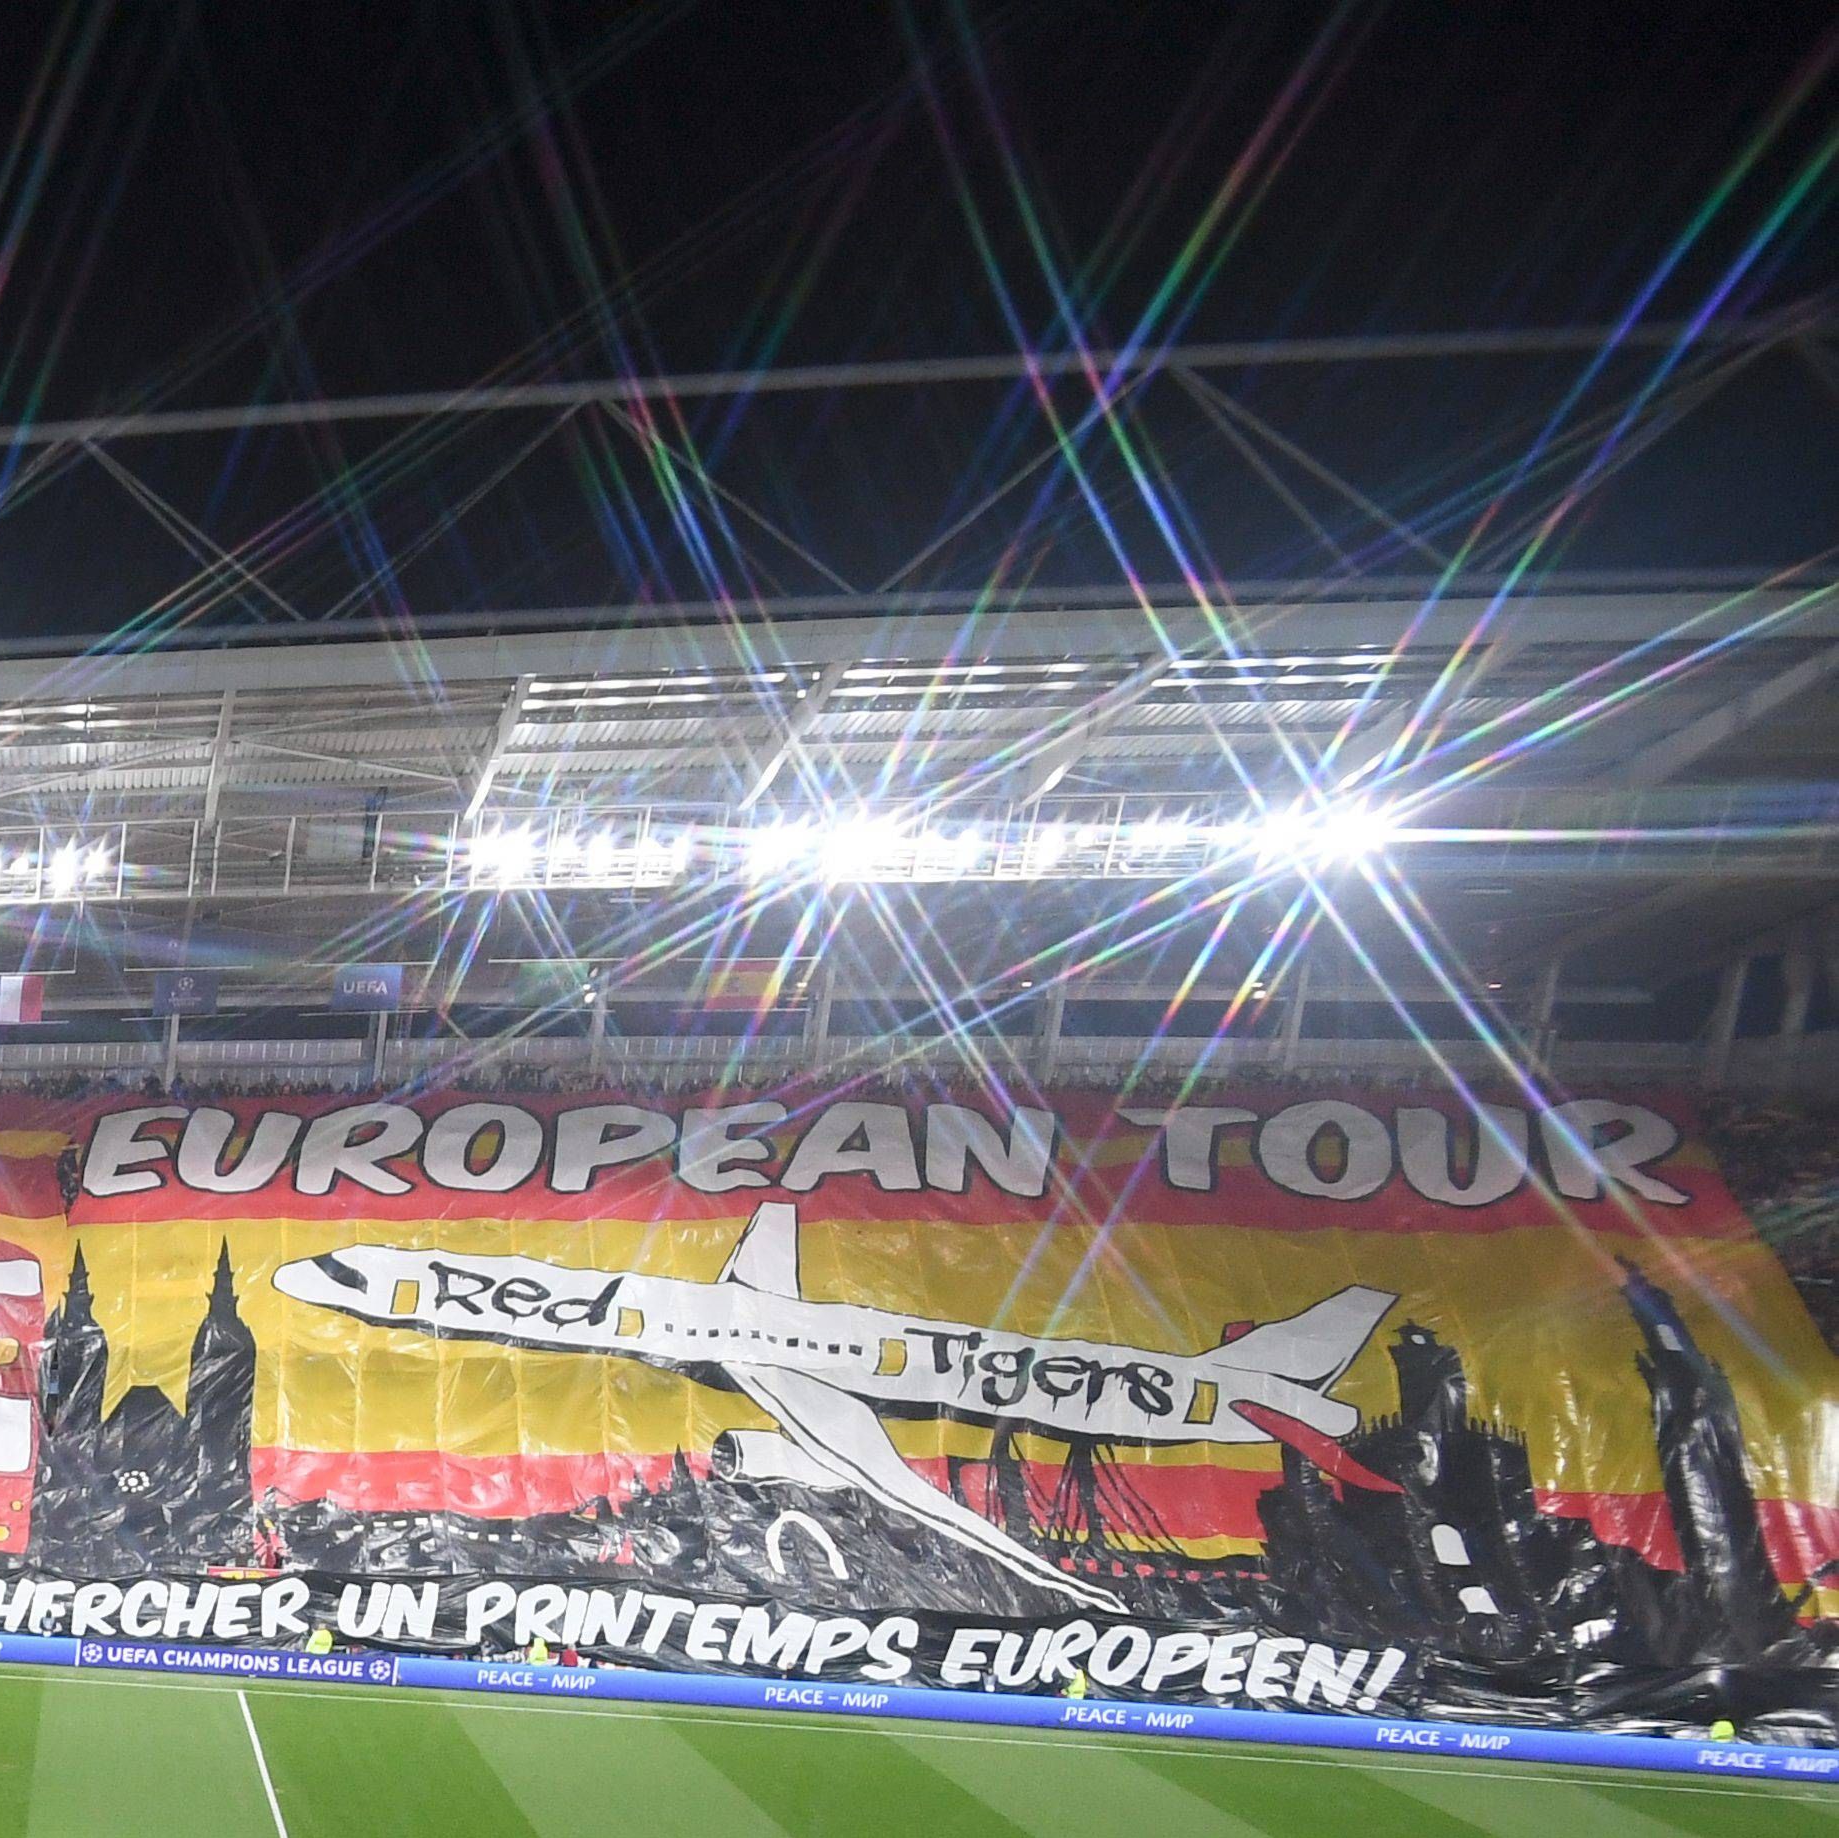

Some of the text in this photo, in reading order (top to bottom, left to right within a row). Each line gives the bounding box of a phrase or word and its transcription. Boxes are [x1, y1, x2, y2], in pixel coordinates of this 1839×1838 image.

[343, 979, 388, 995] UEFA
[83, 1098, 1691, 1206] EUROPEAN TOUR
[427, 1260, 624, 1333] Red
[903, 1326, 1175, 1421] Tigers
[336, 1582, 437, 1639] UN
[465, 1580, 920, 1681] PRINTEMPS
[107, 1646, 364, 1679] UEFA CHAMPIONS LEAGUE
[477, 1669, 533, 1687] PEACE
[764, 1686, 824, 1705] PEACE
[1065, 1706, 1126, 1726] PEACE
[1376, 1727, 1440, 1746] PEACE
[1697, 1749, 1767, 1769] PEACE
